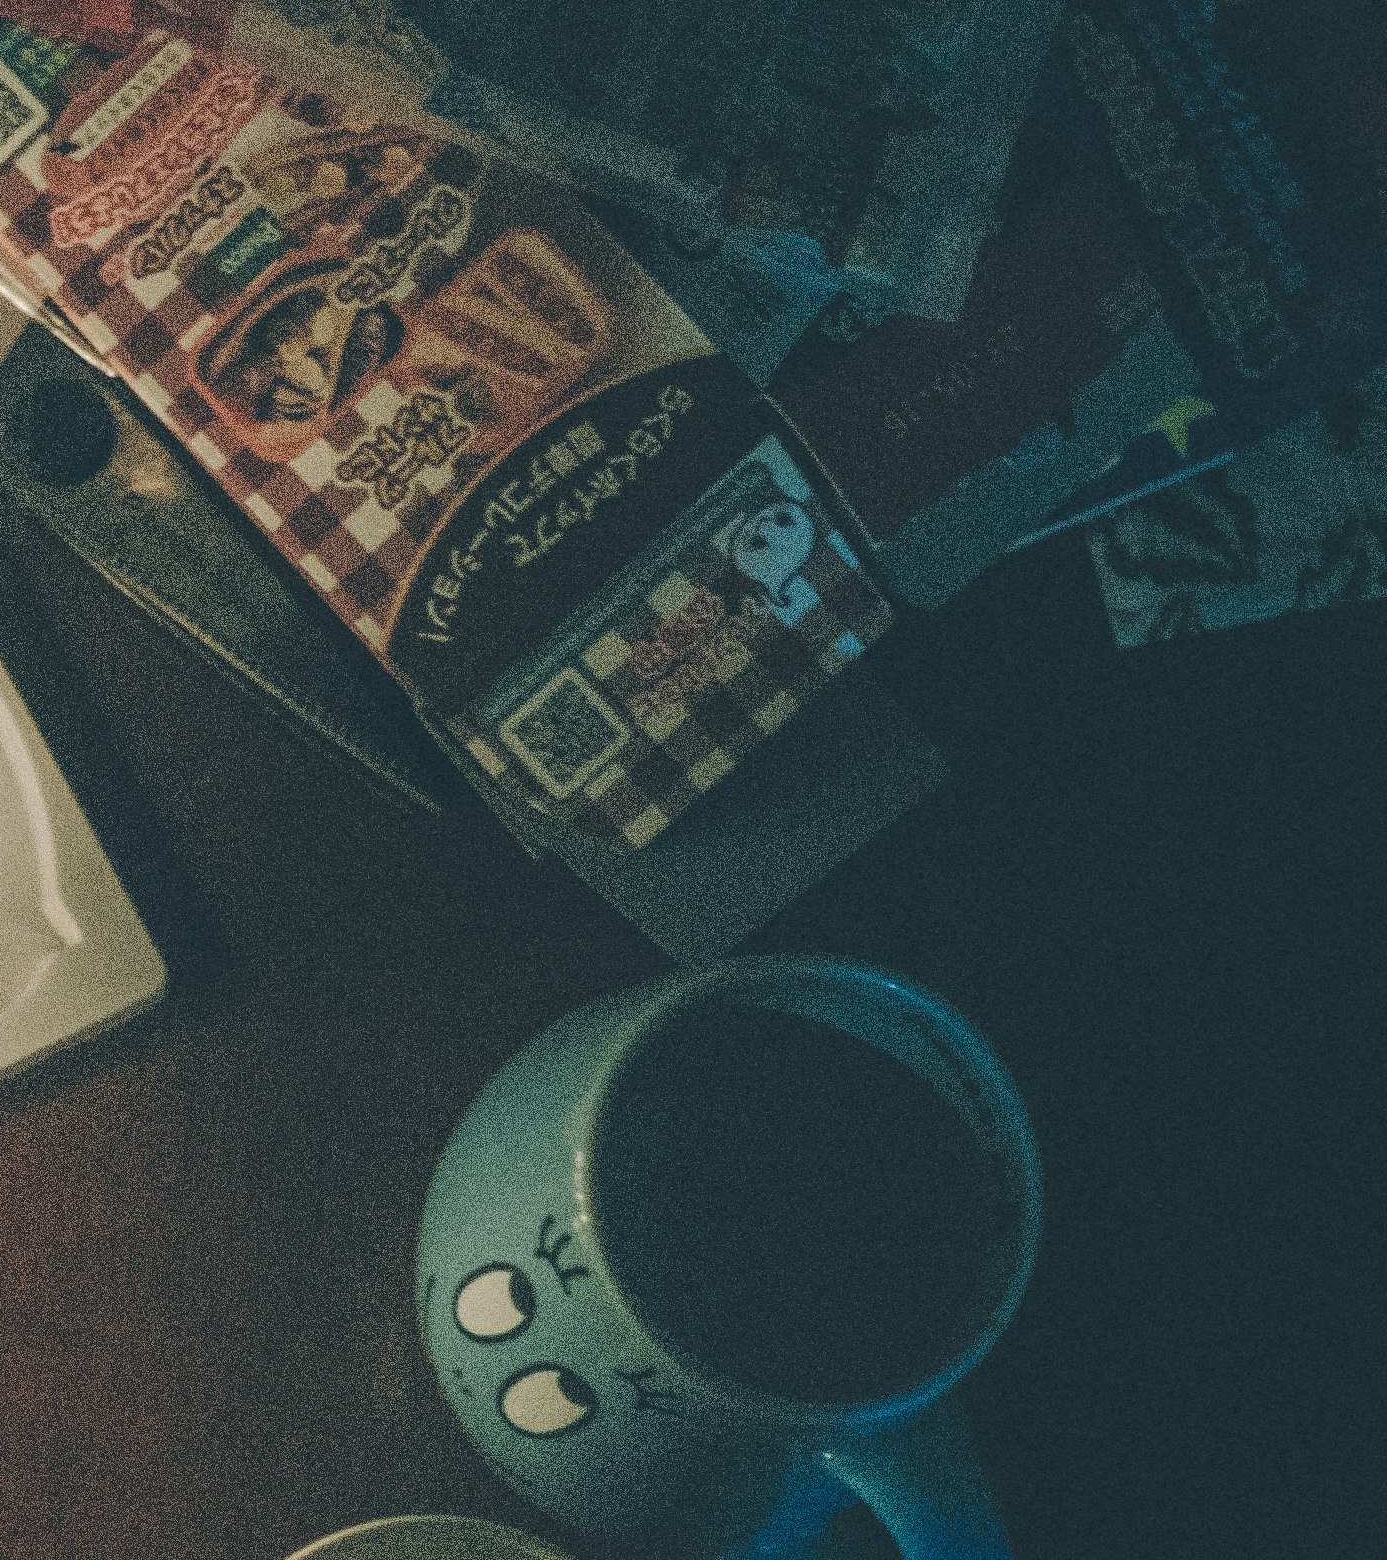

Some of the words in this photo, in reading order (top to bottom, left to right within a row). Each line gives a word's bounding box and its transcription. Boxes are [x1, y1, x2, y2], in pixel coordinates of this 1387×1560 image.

[122, 164, 249, 285] スナックパン
[332, 383, 448, 495] サンドに。
[366, 410, 472, 512] フルーツ
[503, 388, 695, 568] らくらくホイップで
